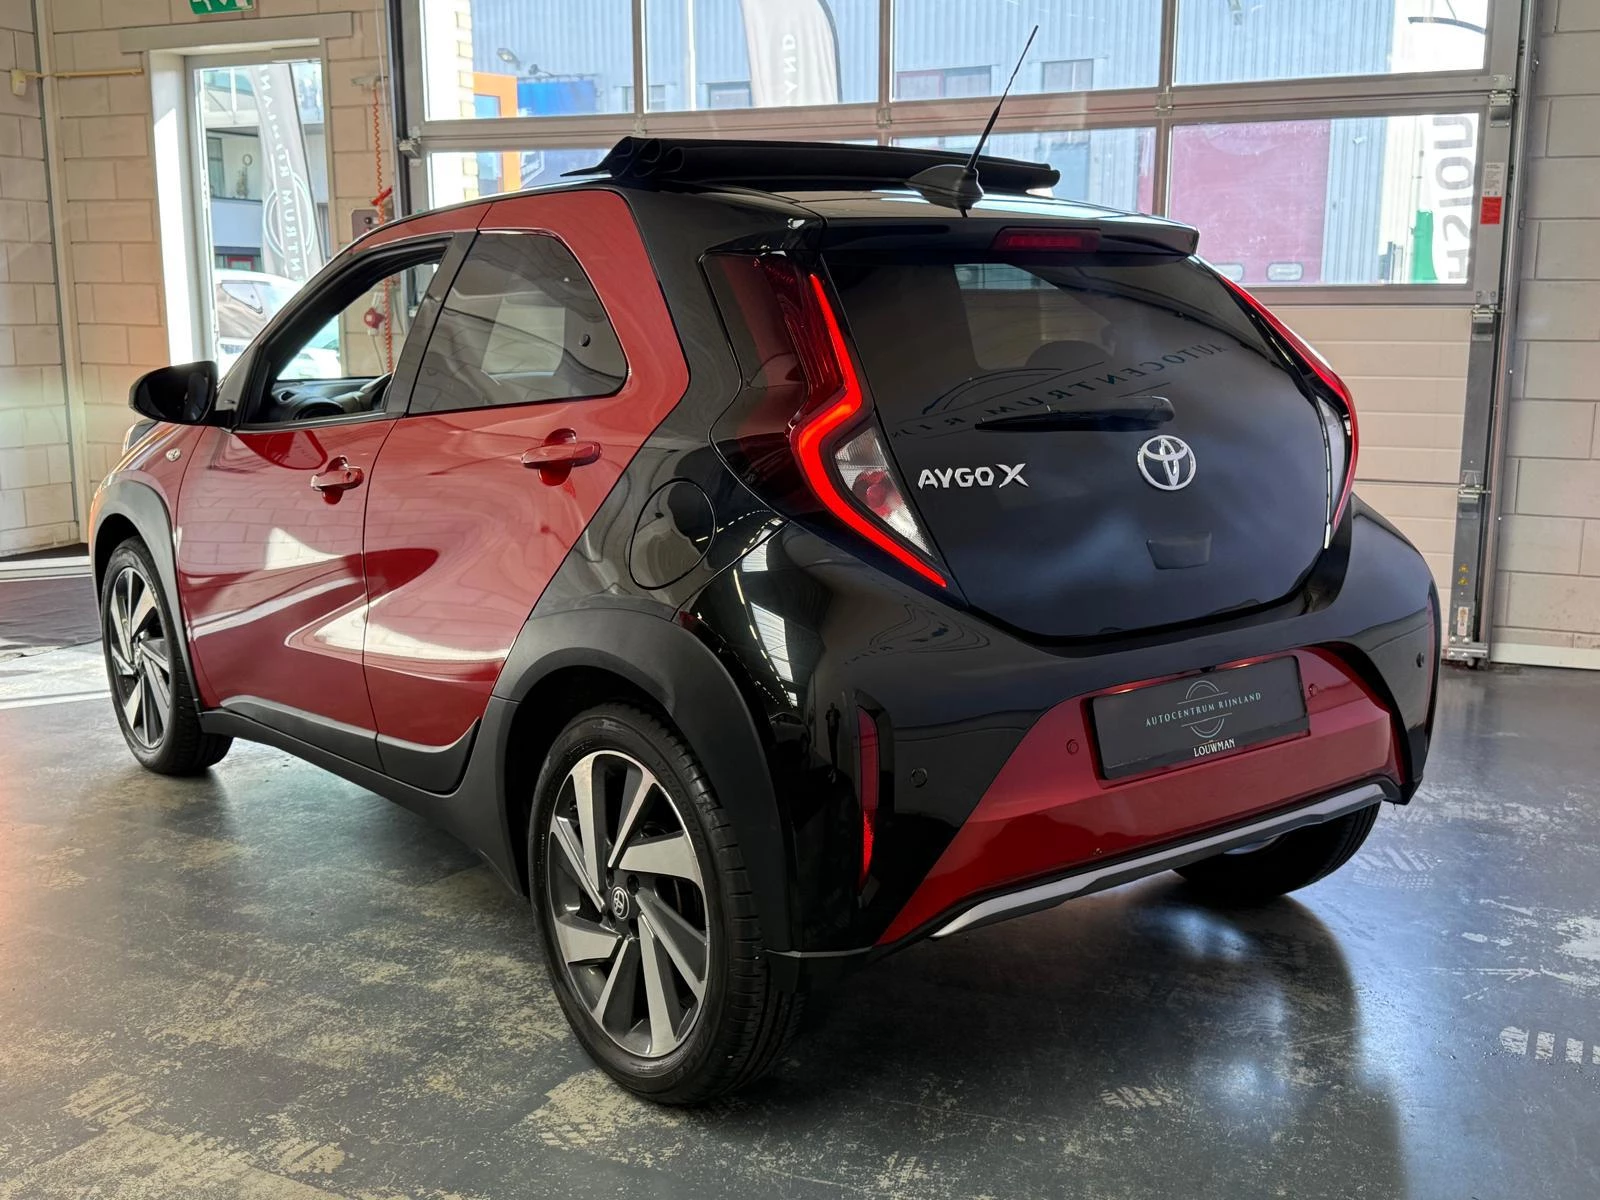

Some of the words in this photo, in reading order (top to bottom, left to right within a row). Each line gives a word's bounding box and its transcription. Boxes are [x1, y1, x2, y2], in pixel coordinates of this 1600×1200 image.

[917, 466, 995, 489] AYGO
[995, 462, 1029, 489] X
[1145, 703, 1216, 728] AUTOCENTRUM
[1218, 691, 1262, 709] RIJNLAND
[1193, 738, 1236, 757] LOUWMAN
